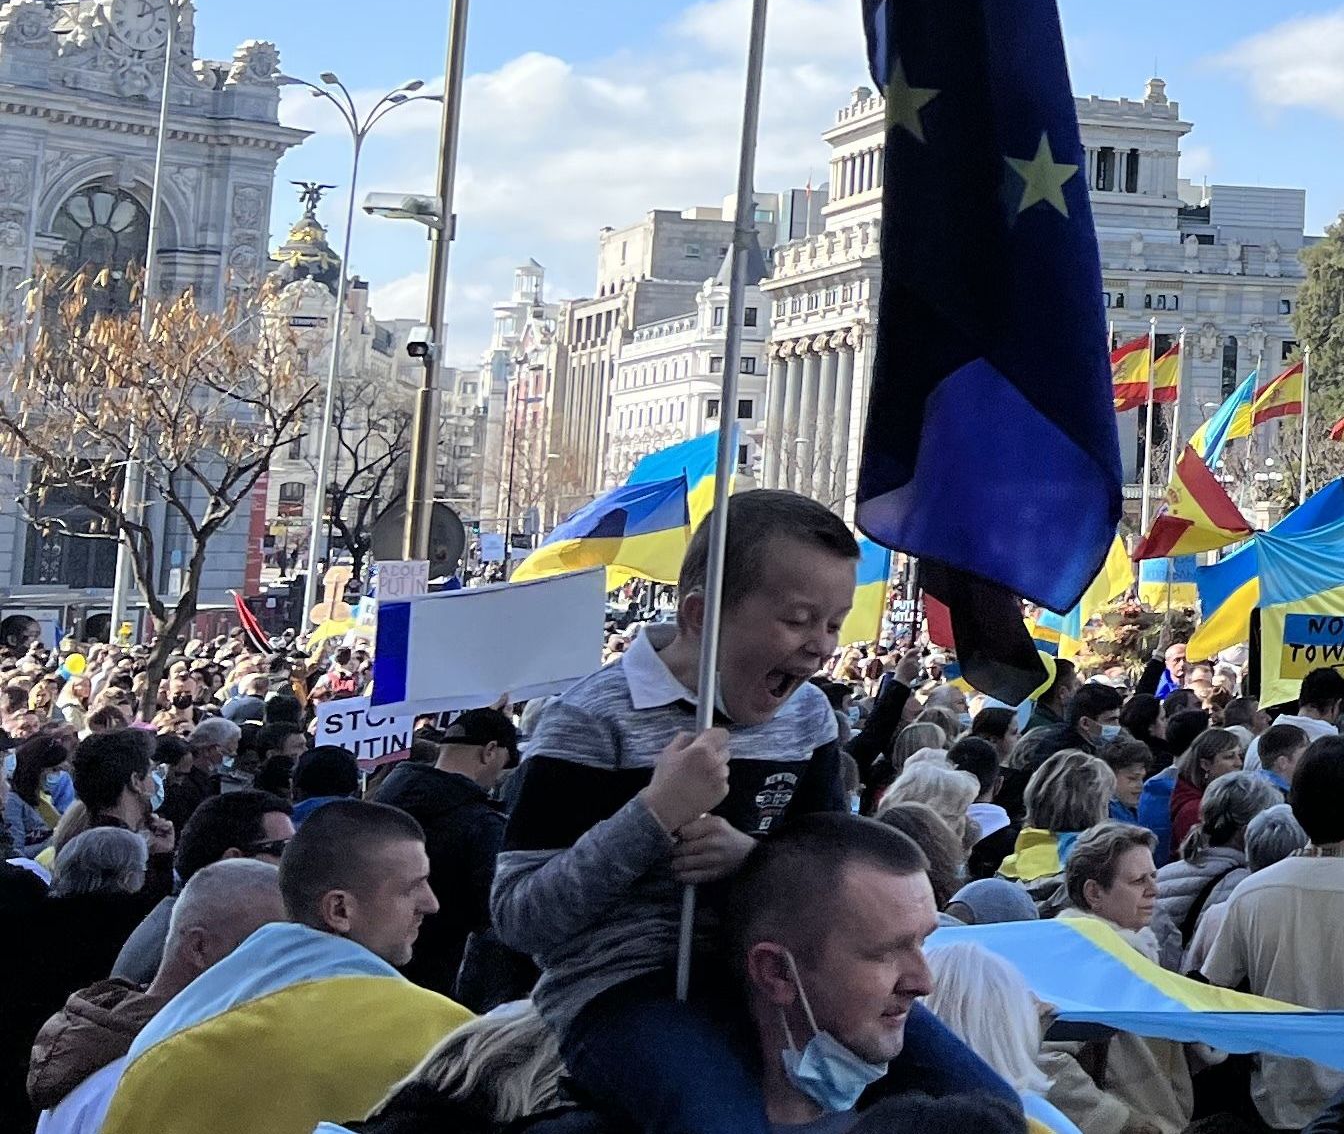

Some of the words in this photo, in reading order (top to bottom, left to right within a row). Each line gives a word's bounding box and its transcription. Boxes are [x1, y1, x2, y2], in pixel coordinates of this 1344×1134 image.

[381, 565, 425, 575] ADOLF
[379, 576, 426, 595] PUTIN
[1308, 617, 1344, 635] NO
[325, 709, 395, 734] STO
[338, 731, 408, 759] UTIN
